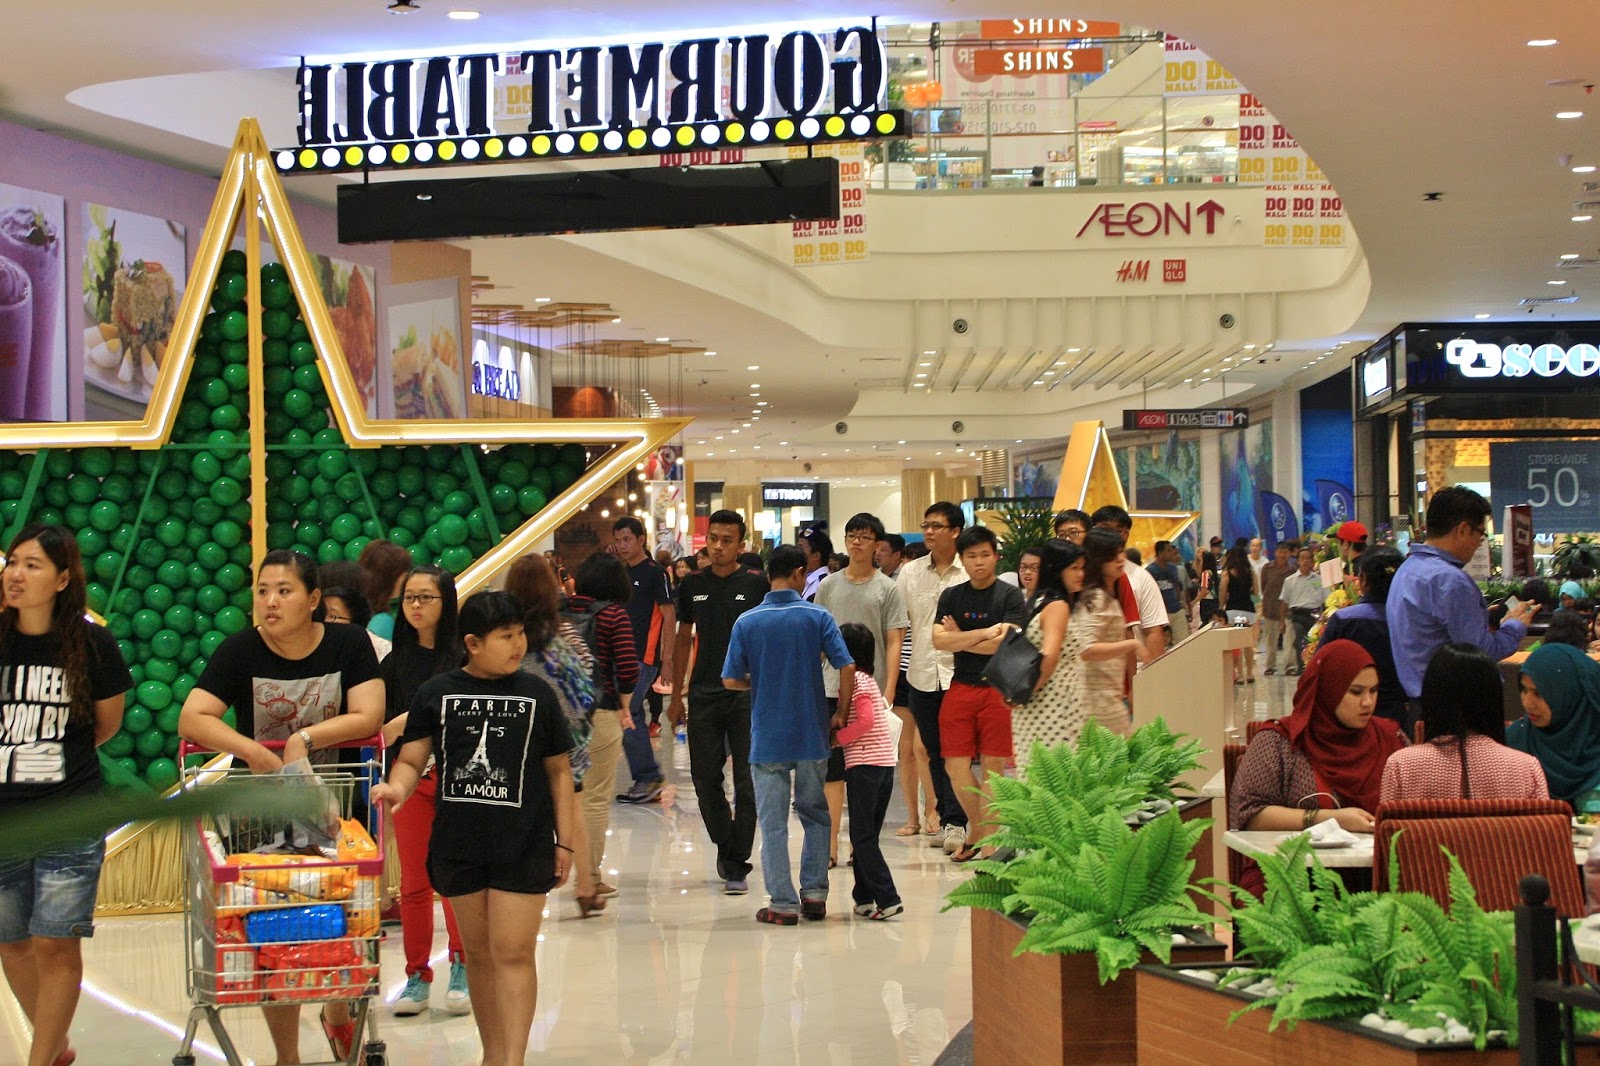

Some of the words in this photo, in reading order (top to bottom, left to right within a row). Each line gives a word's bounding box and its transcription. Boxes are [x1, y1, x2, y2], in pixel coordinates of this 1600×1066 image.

[1013, 19, 1088, 34] SHINS
[1165, 42, 1197, 51] MALL
[1003, 51, 1074, 71] SHINS
[1165, 61, 1197, 82] DO
[1165, 83, 1197, 92] MALL
[1206, 81, 1238, 90] MALL
[1240, 109, 1265, 117] MALL
[1240, 125, 1265, 141] DO
[1273, 125, 1294, 140] D
[841, 162, 860, 175] DO
[1240, 158, 1265, 173] DO
[1273, 157, 1298, 172] DO
[842, 188, 862, 201] DO
[1266, 198, 1287, 210] DO
[1293, 198, 1314, 210] DO
[1321, 198, 1342, 210] DO
[793, 221, 812, 231] DO
[818, 220, 838, 229] DO
[844, 214, 863, 227] DO
[1265, 225, 1287, 238] DO
[1293, 225, 1314, 238] DO
[1320, 225, 1342, 238] DO
[794, 244, 813, 257] DO
[819, 242, 839, 255] DO
[845, 240, 865, 254] DO
[1116, 260, 1150, 282] H&M
[1165, 262, 1183, 270] UNI
[1165, 271, 1184, 280] QLO
[1527, 454, 1589, 465] STOREWIDE
[1527, 467, 1579, 507] 50
[15, 665, 25, 700] I
[453, 700, 526, 713] PARIS
[3, 703, 41, 744] YOU
[41, 705, 70, 740] BY
